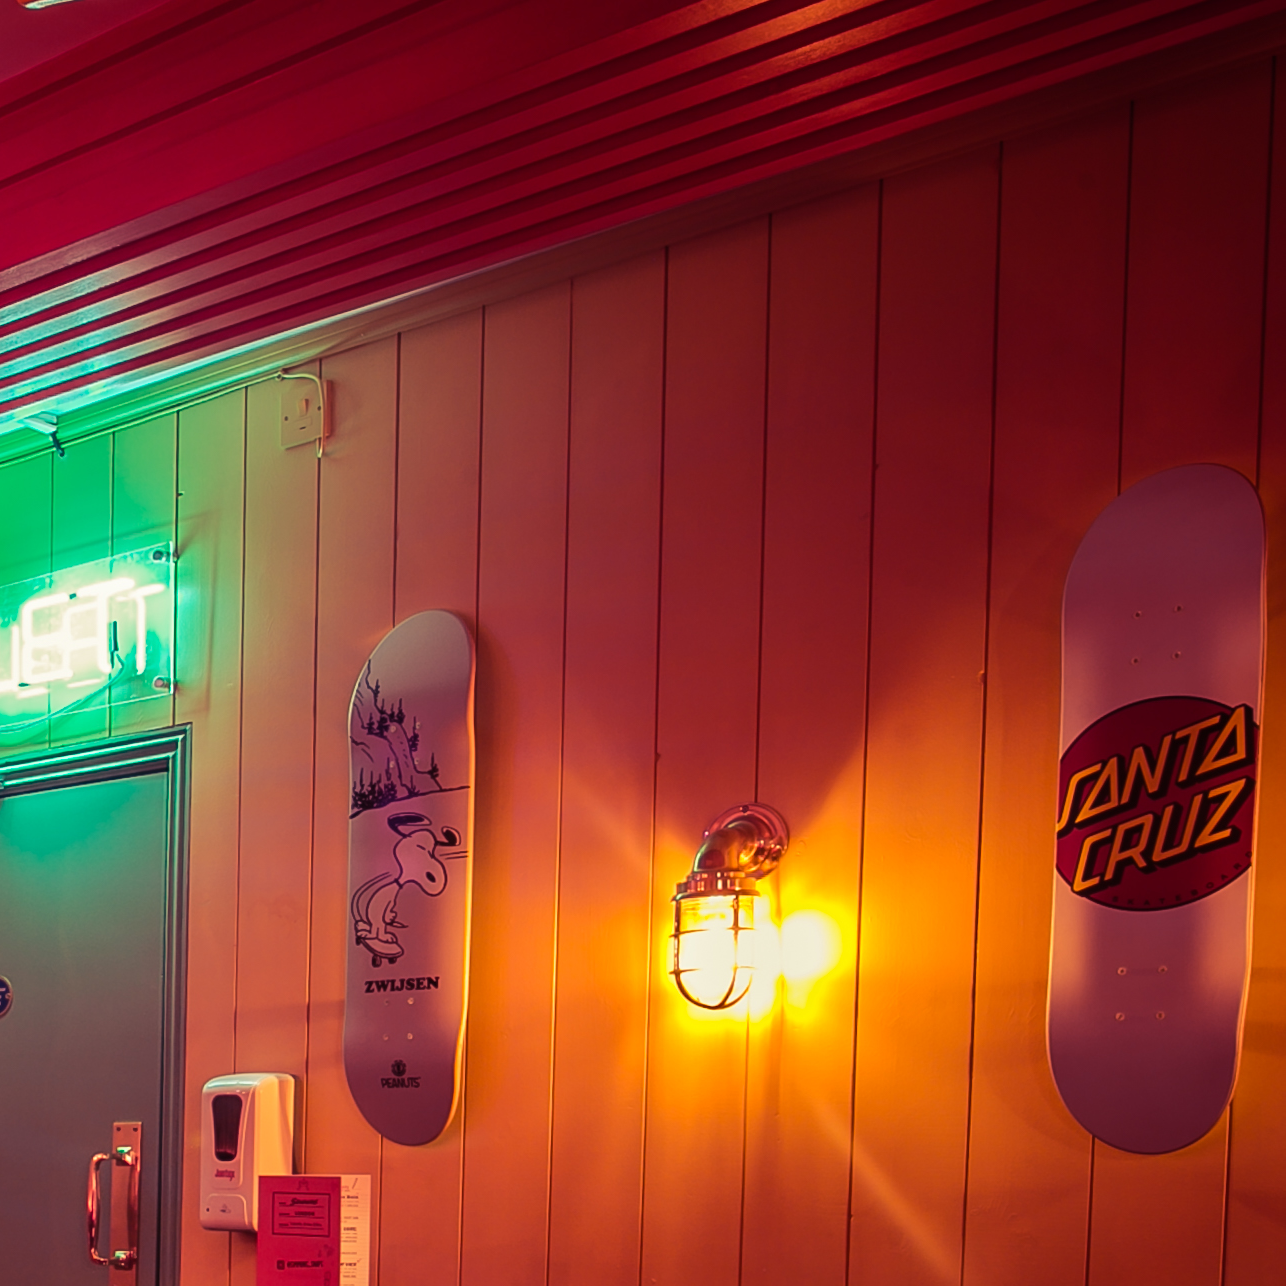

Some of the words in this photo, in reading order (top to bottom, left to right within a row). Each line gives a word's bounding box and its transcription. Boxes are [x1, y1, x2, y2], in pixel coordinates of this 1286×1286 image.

[1056, 704, 1251, 838] SANTA
[1073, 777, 1251, 895] CRUZ
[364, 976, 440, 994] ZWIJSEN
[380, 1077, 420, 1088] PEANUTS
